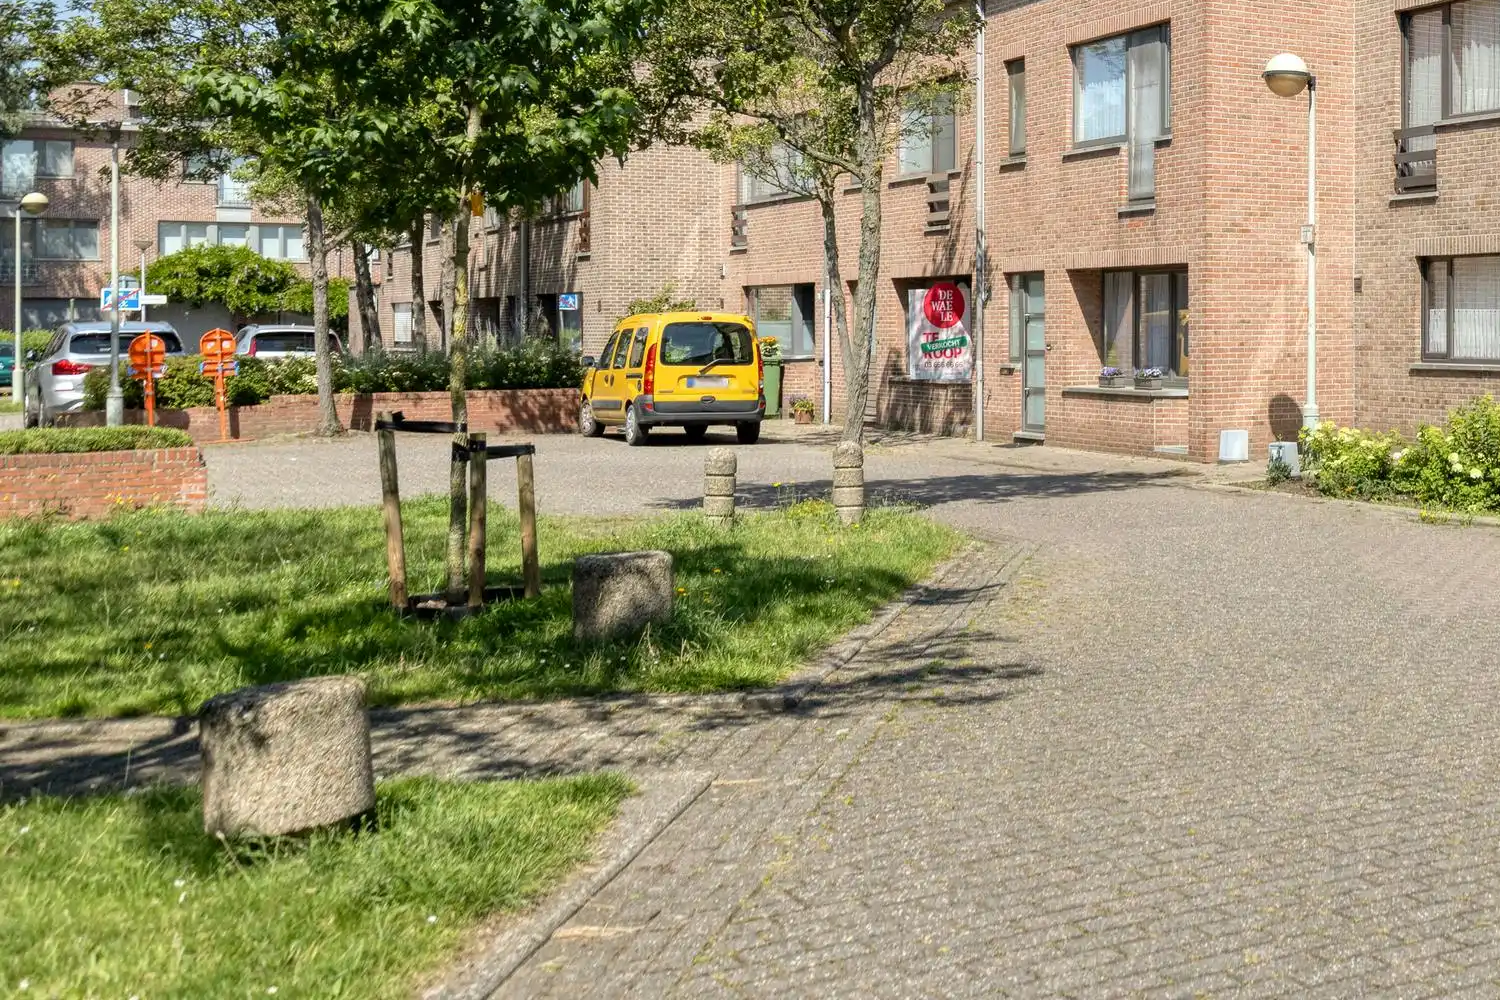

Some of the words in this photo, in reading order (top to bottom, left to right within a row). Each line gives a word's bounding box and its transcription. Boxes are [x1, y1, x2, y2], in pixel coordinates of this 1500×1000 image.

[938, 289, 953, 300] DE
[931, 300, 953, 311] WAE
[940, 311, 953, 322] LE
